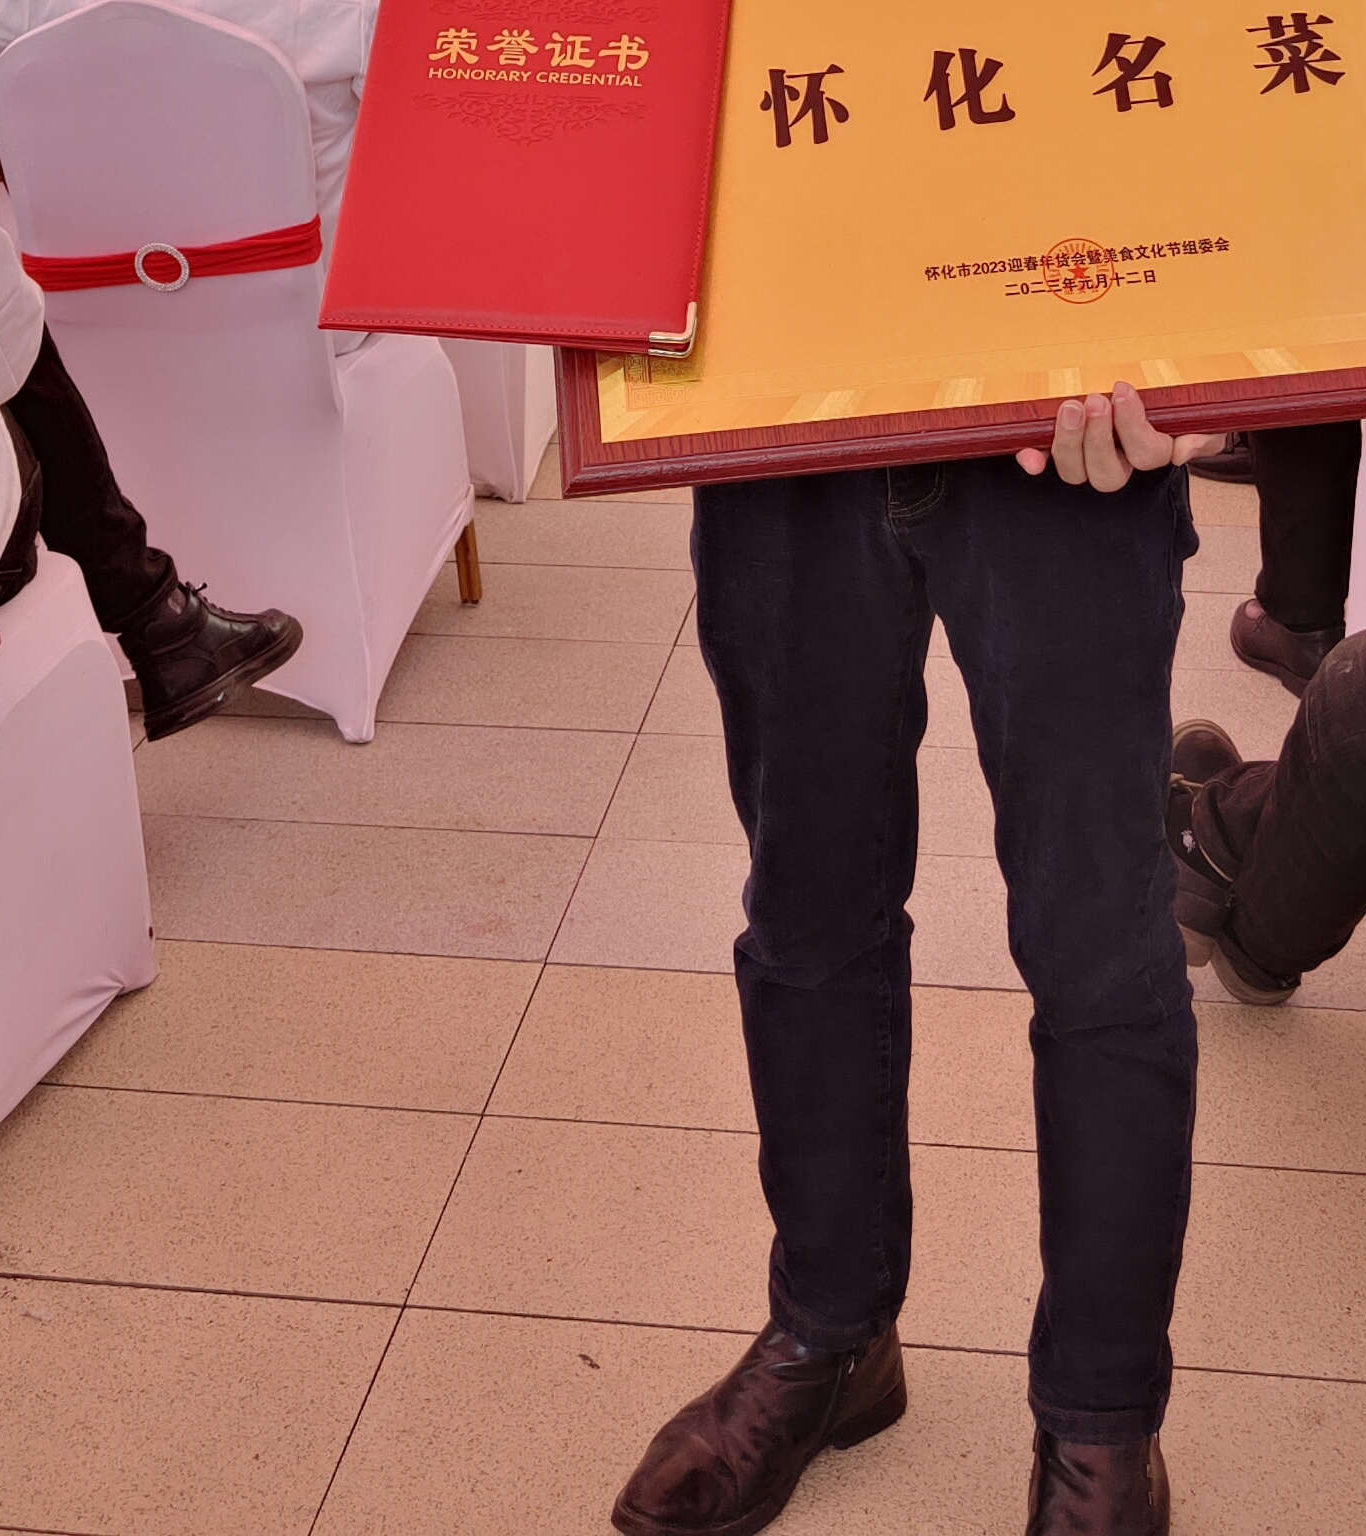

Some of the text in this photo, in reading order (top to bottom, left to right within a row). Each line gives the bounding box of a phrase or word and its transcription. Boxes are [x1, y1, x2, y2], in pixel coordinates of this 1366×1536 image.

[428, 27, 649, 72] 荣誉证书
[428, 67, 642, 87] HONORARY CREDENTIAL
[759, 11, 1346, 148] 怀化名菜
